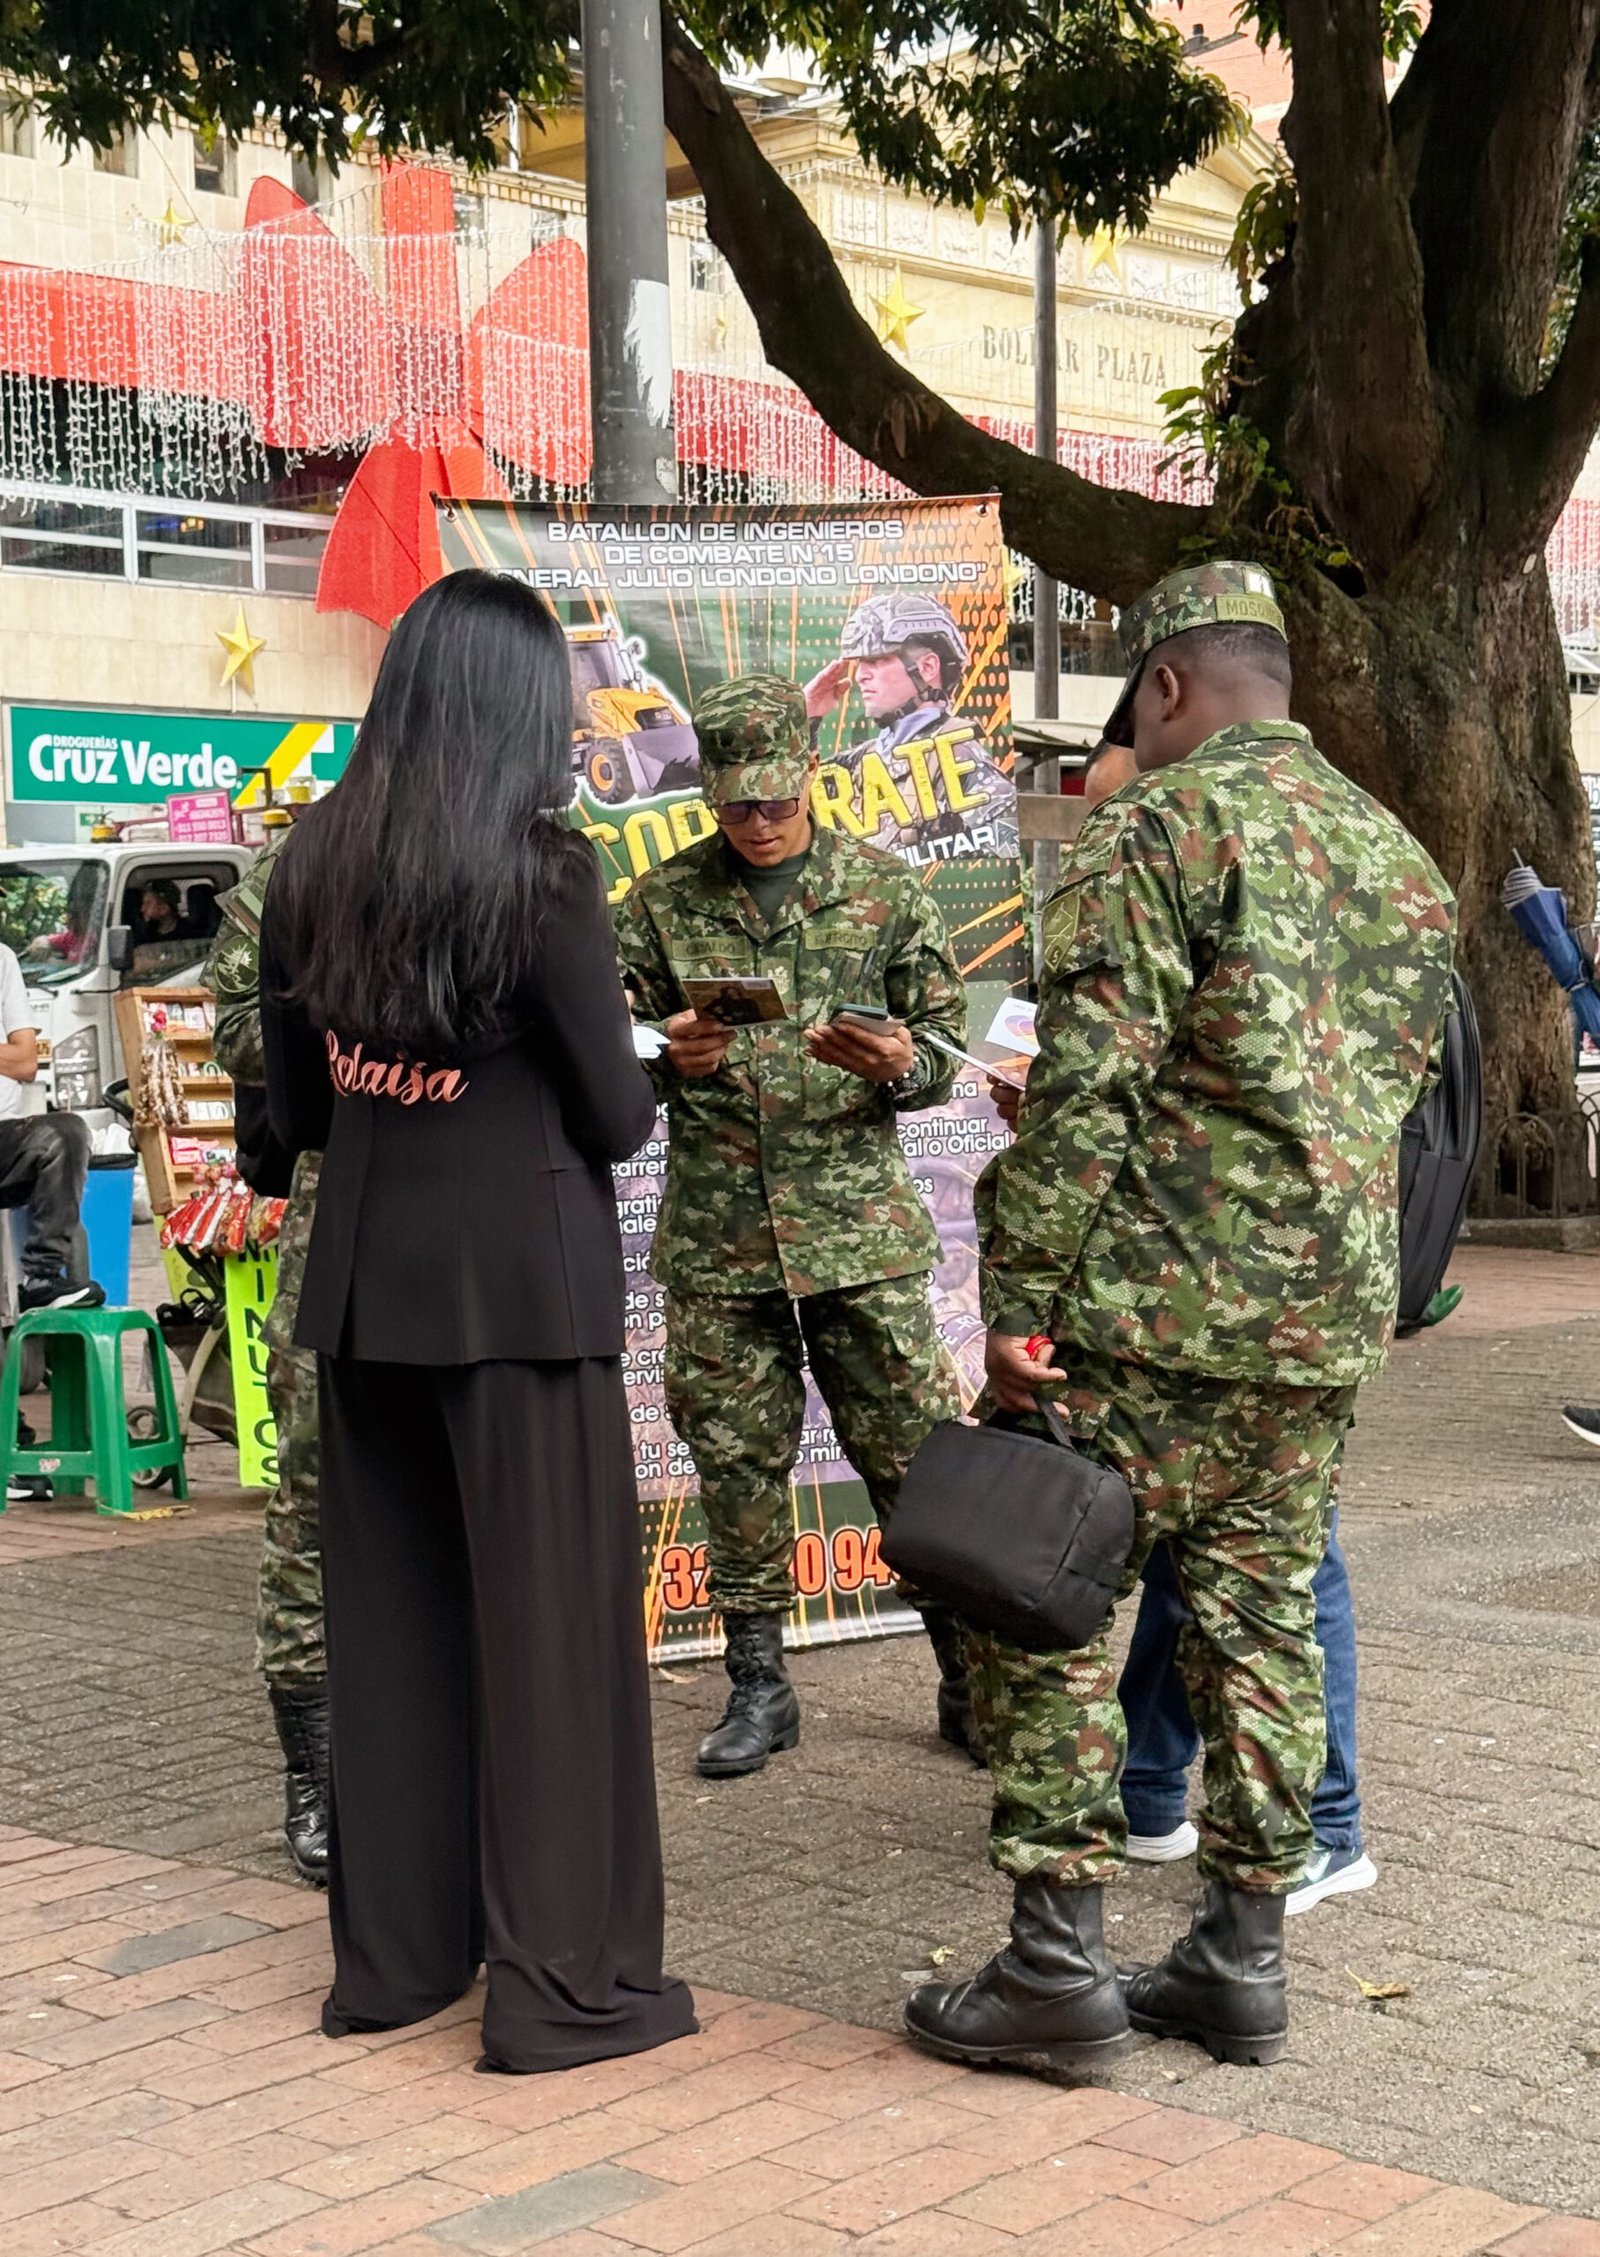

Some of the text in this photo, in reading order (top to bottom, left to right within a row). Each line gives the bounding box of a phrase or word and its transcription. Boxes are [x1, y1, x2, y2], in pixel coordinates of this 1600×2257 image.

[1097, 344, 1168, 389] PLAZA
[548, 520, 904, 542] BATALLON DE INGENIEROS
[604, 545, 642, 566] DE
[649, 544, 784, 565] COMBATE
[616, 567, 694, 588] JULIO
[52, 734, 118, 749] DROGUERÍAS
[28, 734, 238, 789] Cruz Verde
[947, 1131, 1010, 1154] Oficial
[640, 1441, 661, 1460] tu
